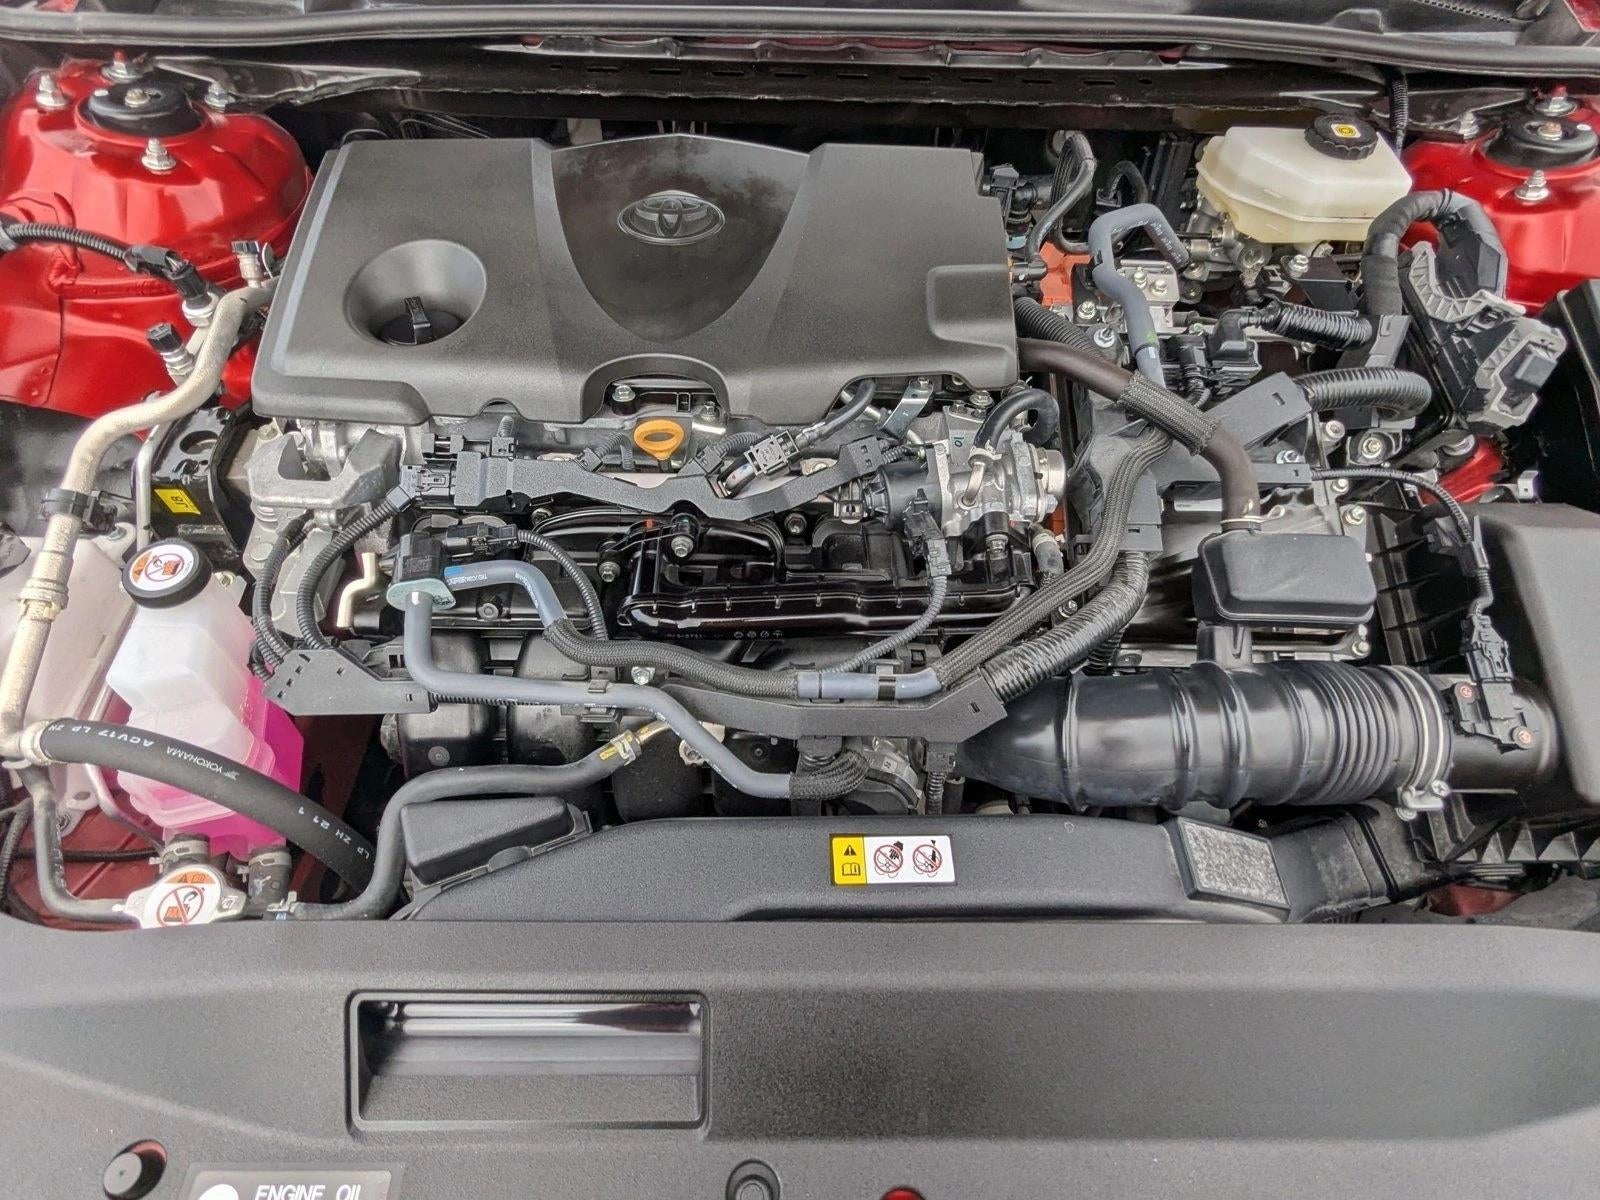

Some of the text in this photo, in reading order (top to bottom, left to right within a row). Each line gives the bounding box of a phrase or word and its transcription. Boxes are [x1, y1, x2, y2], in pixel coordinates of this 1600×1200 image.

[72, 726, 91, 734] LP
[98, 730, 154, 747] ACV17
[165, 746, 223, 773] YOKOHAMA
[335, 829, 352, 845] ZH
[255, 1184, 325, 1200] ENGINE
